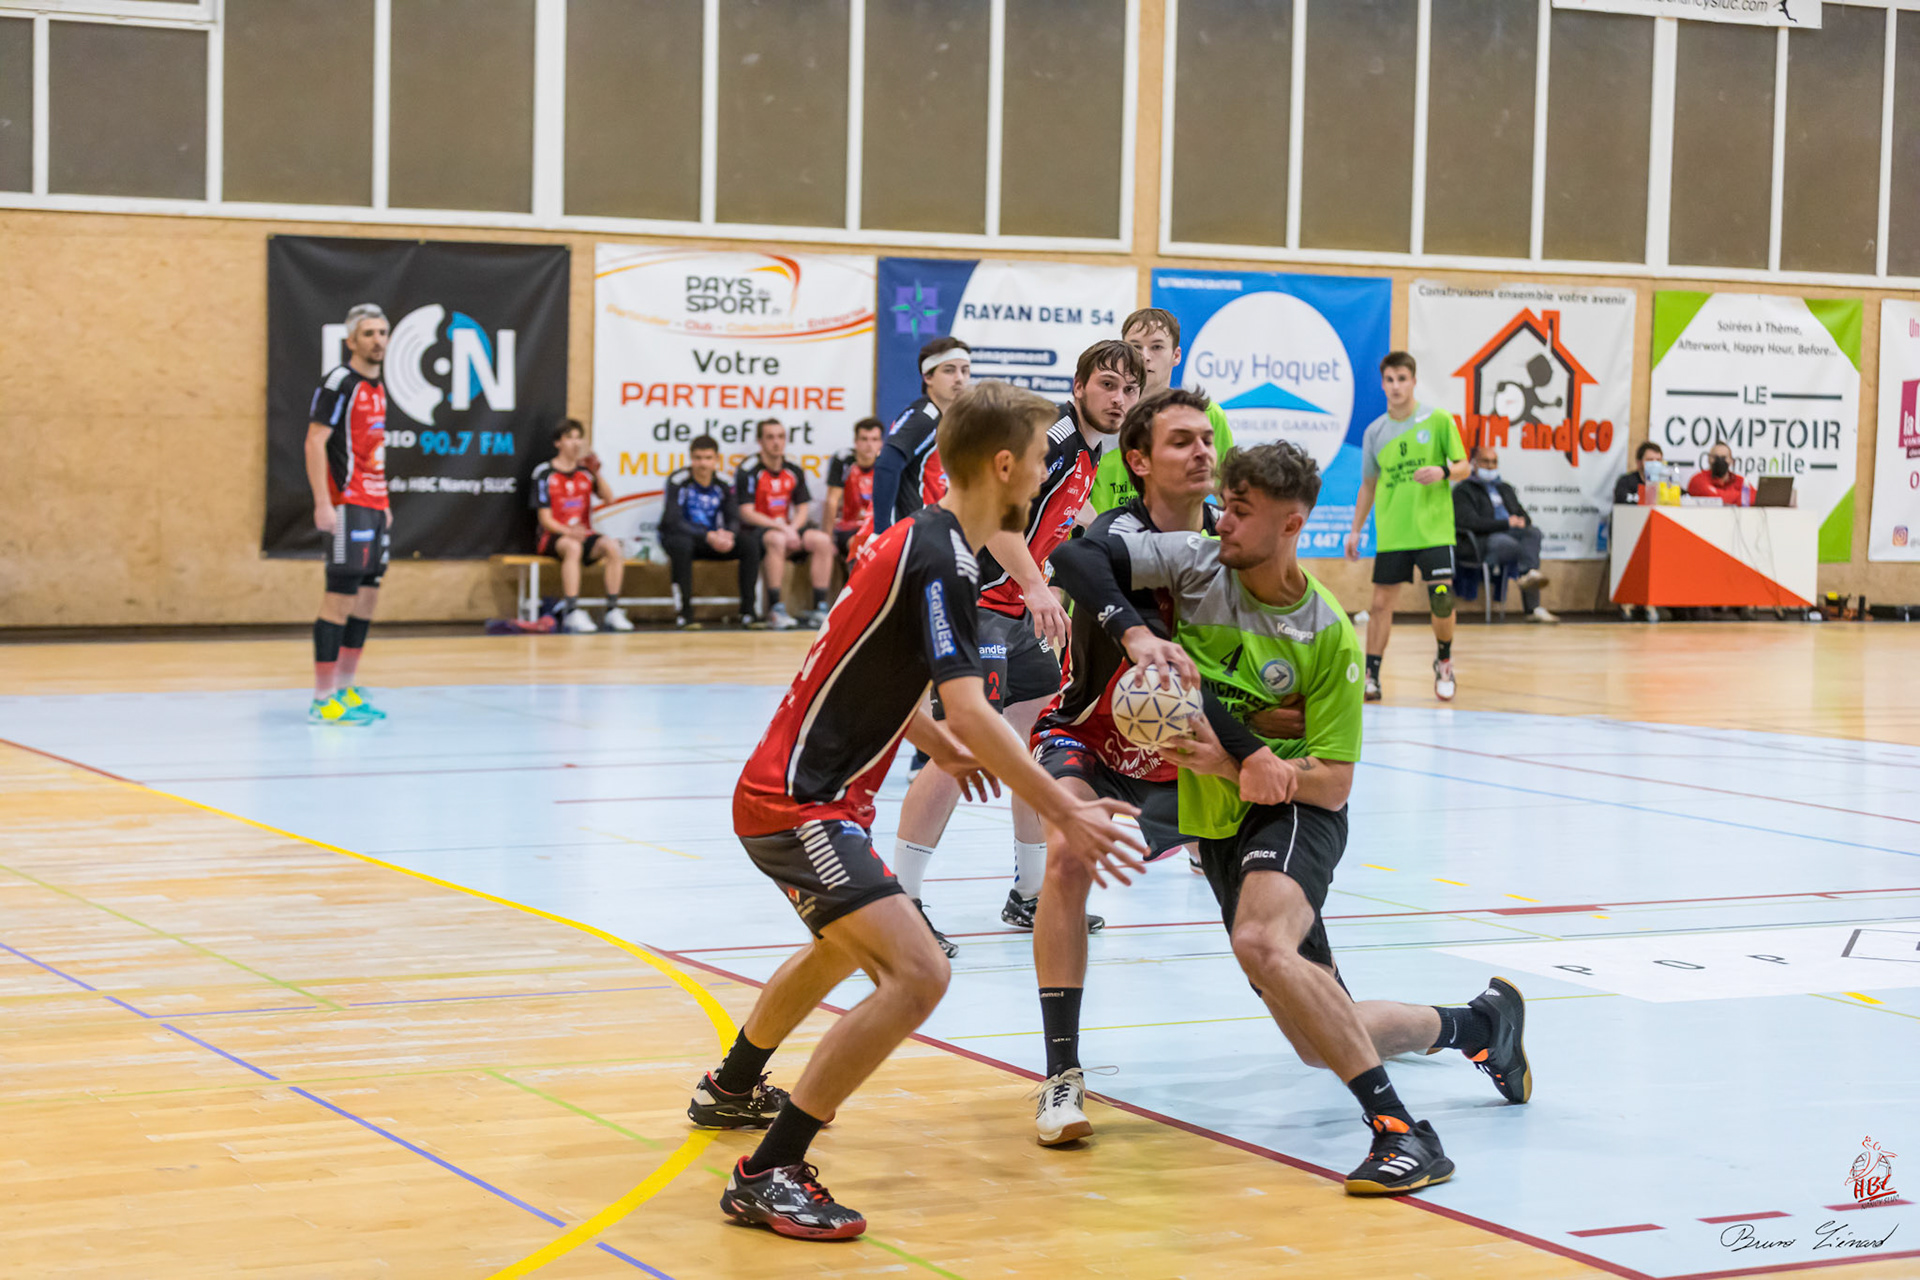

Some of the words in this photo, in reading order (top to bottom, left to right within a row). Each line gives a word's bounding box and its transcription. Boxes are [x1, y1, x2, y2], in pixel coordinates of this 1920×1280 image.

[686, 275, 753, 295] PAYS
[1418, 285, 1494, 298] Construisons
[1498, 288, 1553, 301] ensemble
[1557, 292, 1588, 304] votre
[1592, 293, 1627, 305] avenir
[686, 295, 771, 314] SPORT
[963, 304, 1032, 322] RAYAN
[1039, 307, 1082, 324] DEM
[1090, 309, 1115, 325] 54
[1717, 319, 1752, 333] Soirées
[1756, 321, 1762, 333] à
[969, 349, 1050, 365] ménagement
[1734, 341, 1764, 355] Happy
[692, 350, 780, 375] Votre
[1195, 351, 1244, 383] Guy
[1252, 354, 1341, 385] Hoquet
[620, 382, 845, 411] PARTENAIRE
[1744, 385, 1767, 405] LE
[383, 430, 417, 448] DIO
[419, 430, 474, 455] 90.7
[479, 431, 515, 455] FM
[653, 419, 691, 443] de
[703, 419, 813, 445] l'efrt
[1664, 416, 1841, 450] COMPTOIR
[1700, 451, 1805, 479] Cmpanile
[930, 580, 955, 656] GrandEst
[1277, 622, 1314, 641] Kempa
[1220, 643, 1244, 678] 4
[988, 671, 1000, 700] 2
